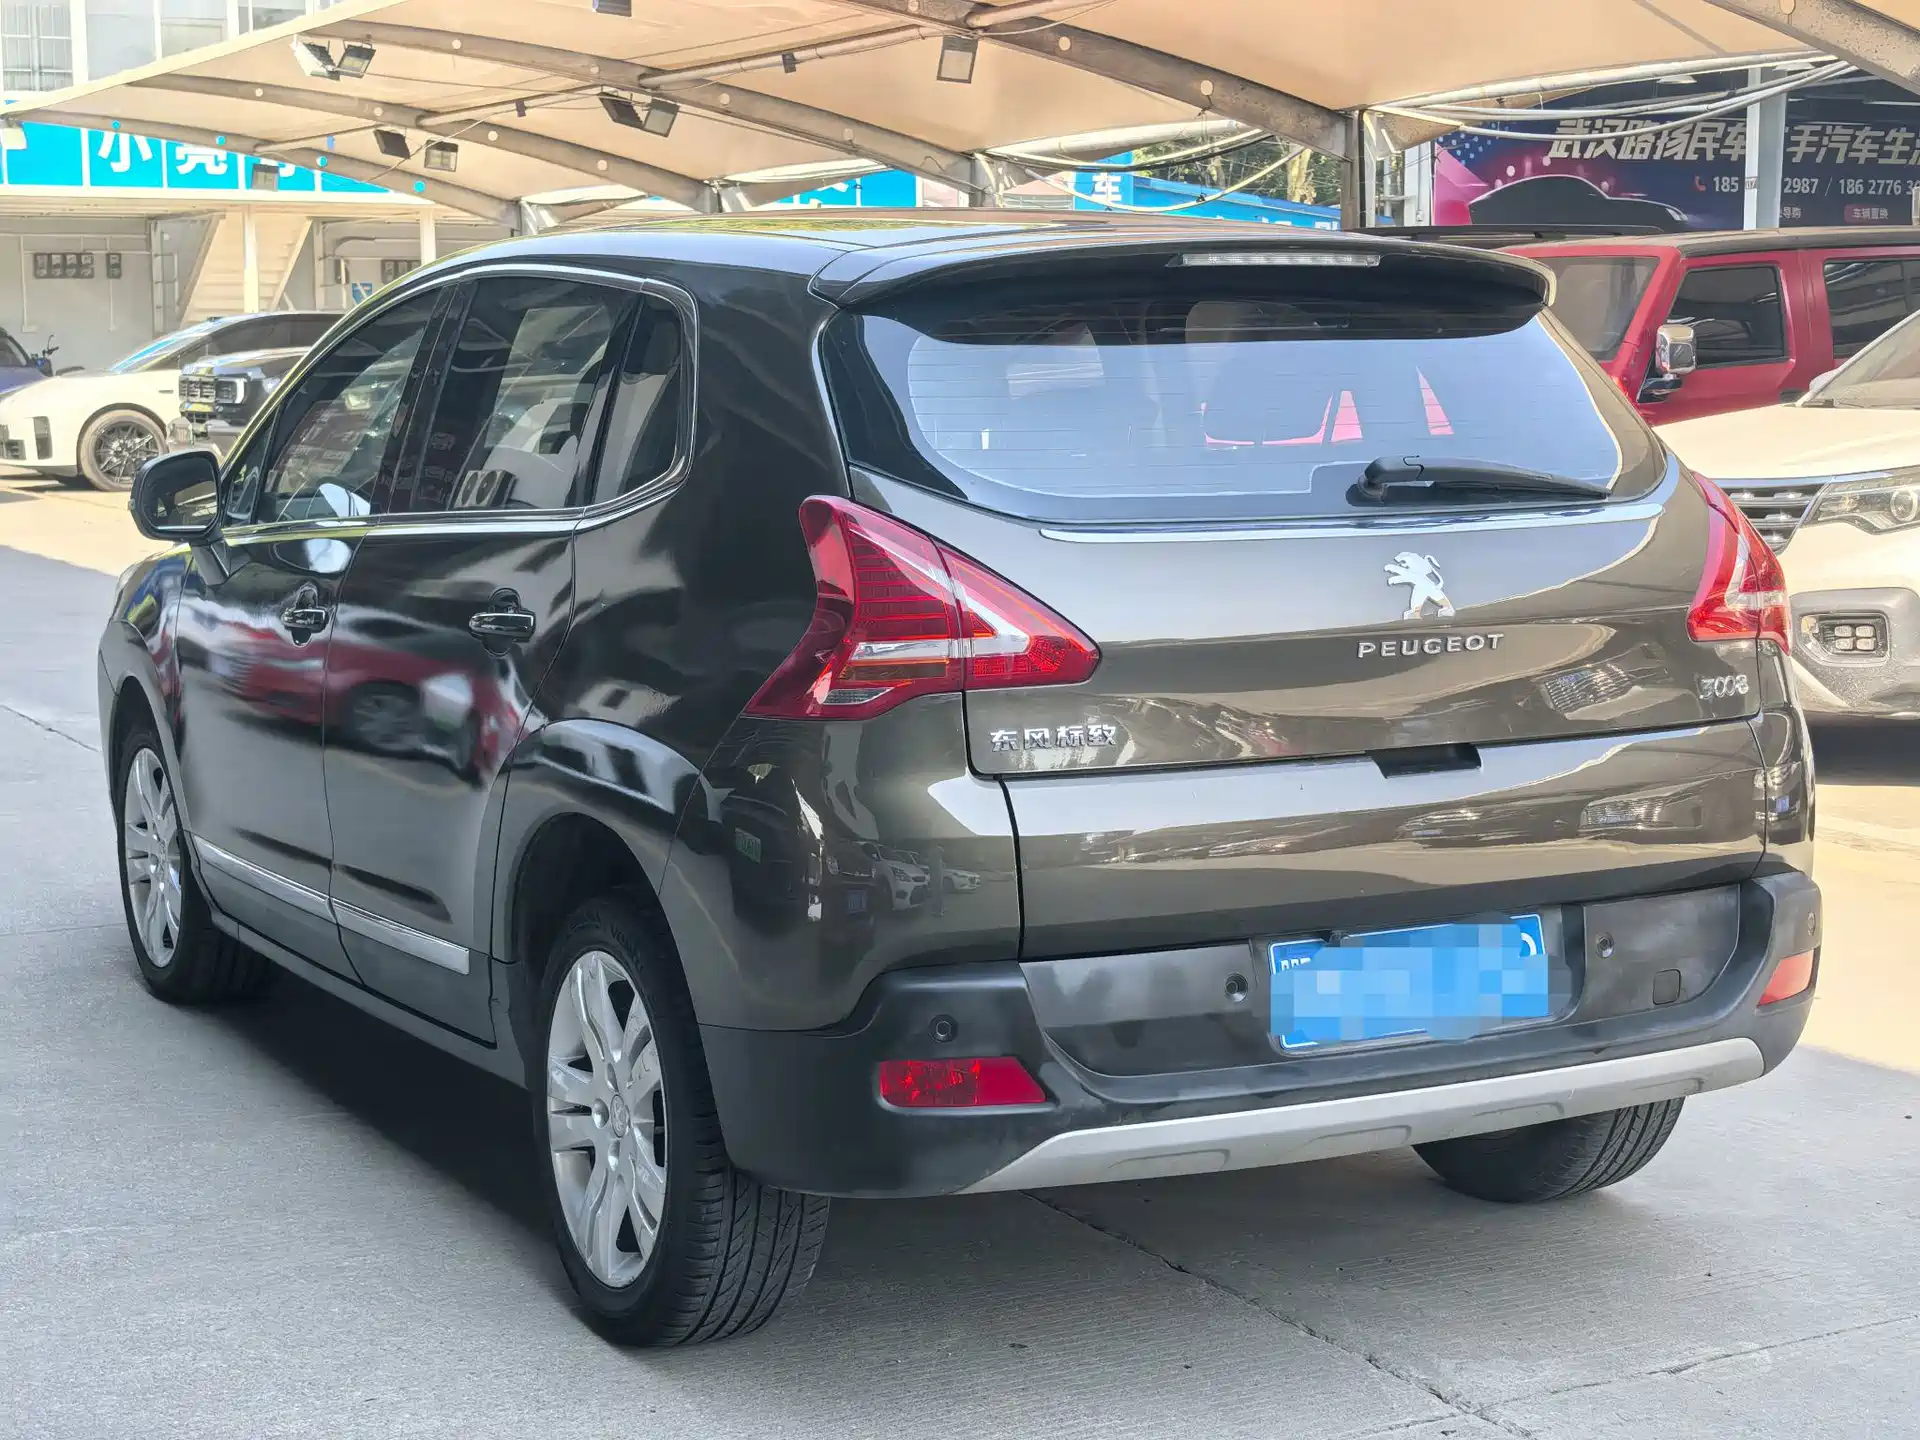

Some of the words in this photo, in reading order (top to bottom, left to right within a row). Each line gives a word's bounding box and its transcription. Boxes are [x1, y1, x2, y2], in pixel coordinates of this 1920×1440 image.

[1713, 176, 1740, 193] 185
[1783, 177, 1819, 194] 2987
[1839, 178, 1864, 195] 186
[1868, 179, 1901, 196] 2776
[1357, 633, 1504, 658] PEUGEOT
[1699, 674, 1749, 700] 3008
[989, 723, 1117, 752] 东风标致
